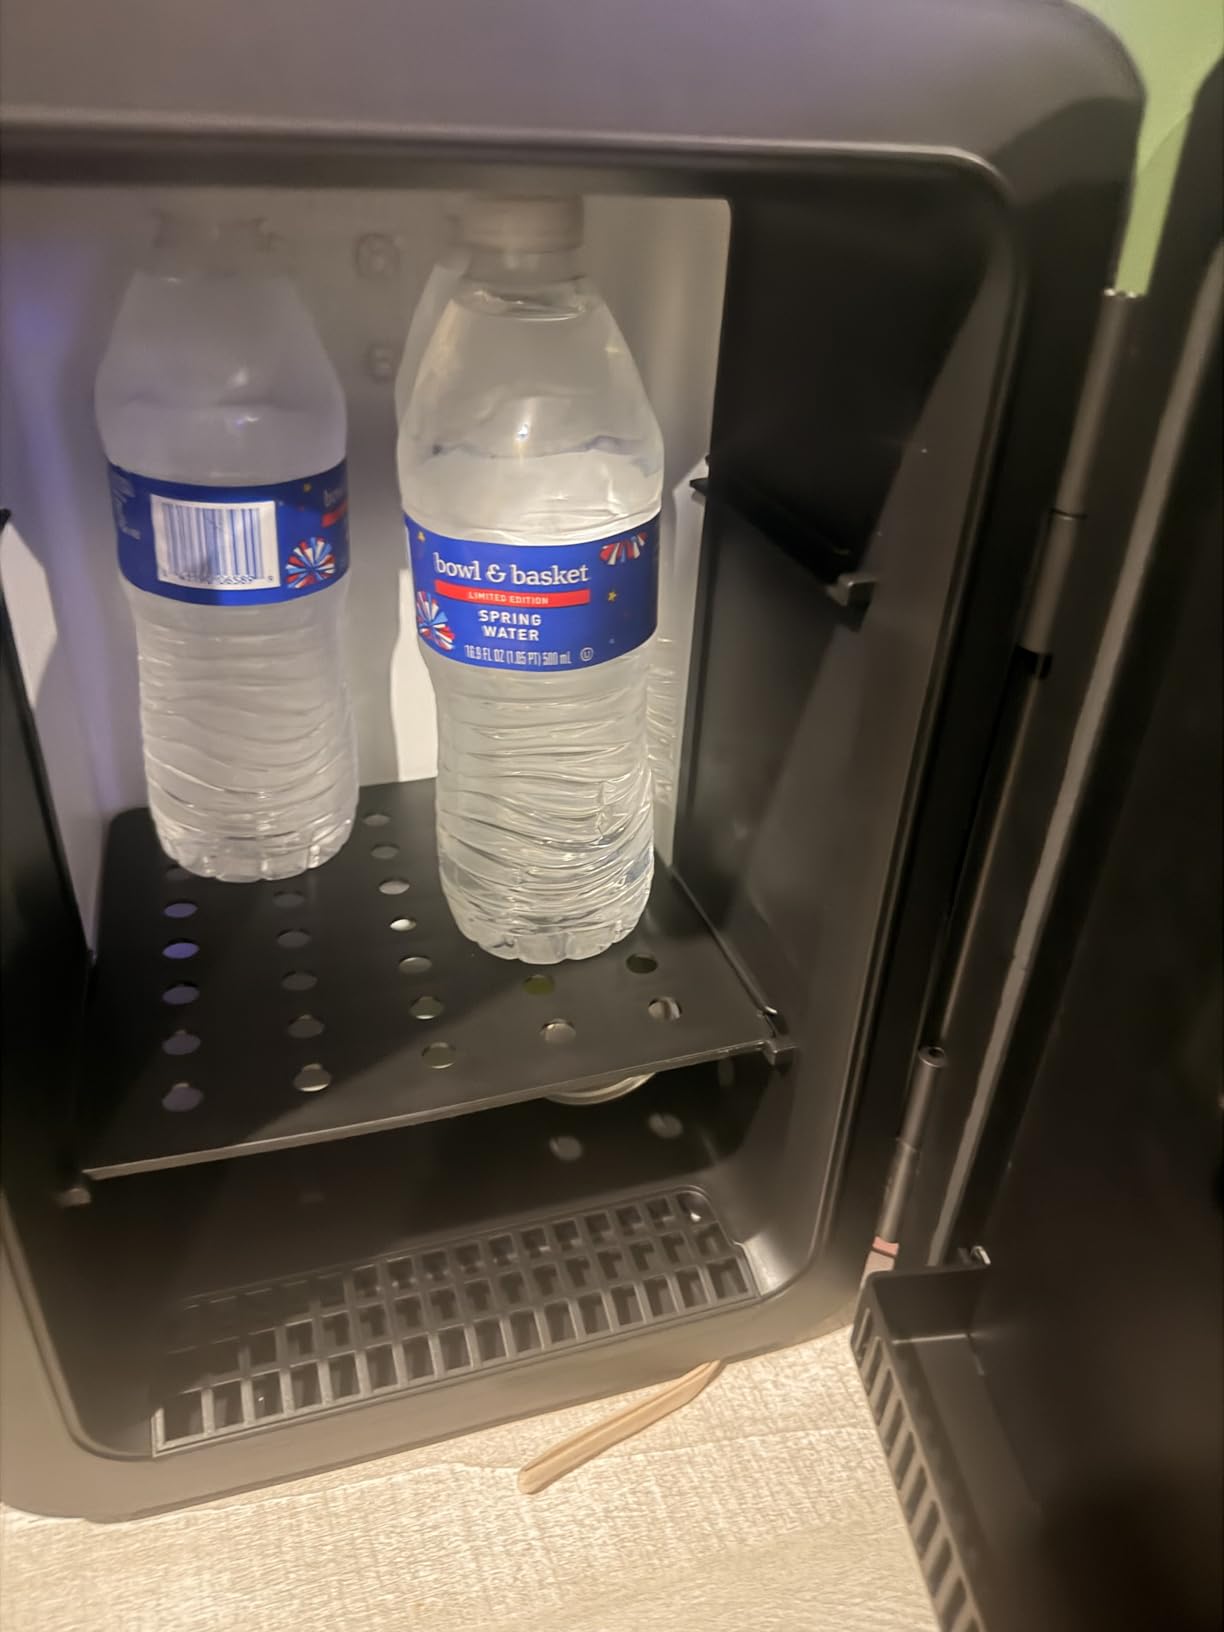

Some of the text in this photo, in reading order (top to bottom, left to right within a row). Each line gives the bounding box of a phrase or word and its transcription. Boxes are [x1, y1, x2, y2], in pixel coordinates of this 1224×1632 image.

[433, 552, 589, 586] bowl & basket
[468, 592, 549, 606] LIMITED EDITION
[479, 610, 541, 626] SPRING
[483, 625, 539, 641] WATER
[483, 647, 492, 661] FL
